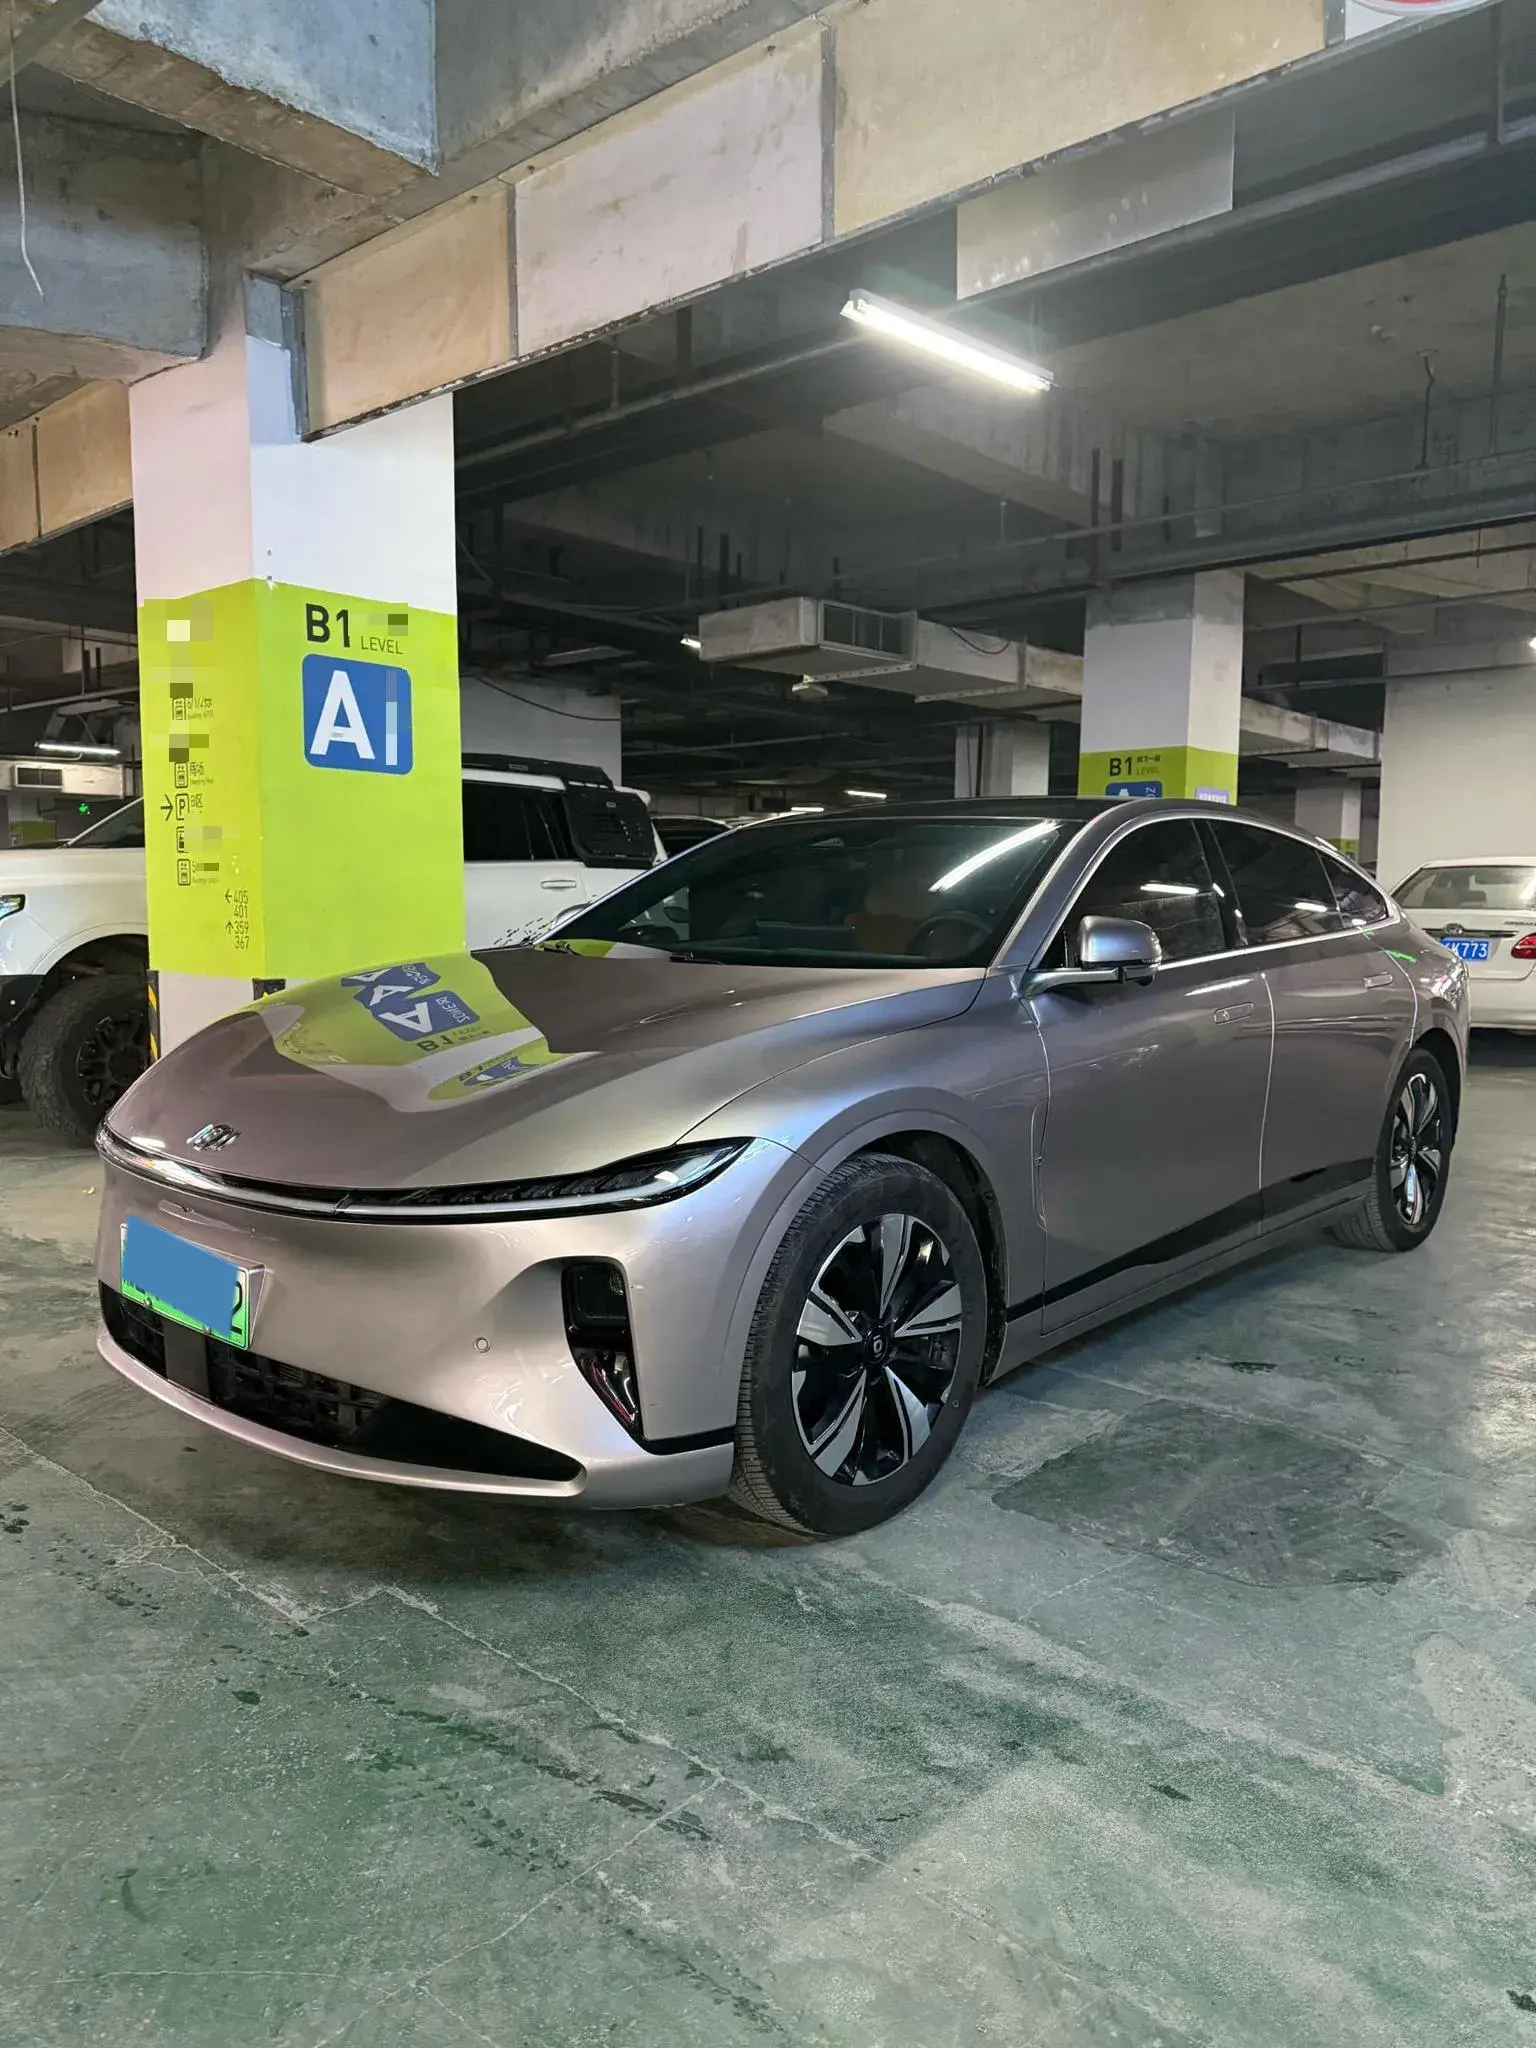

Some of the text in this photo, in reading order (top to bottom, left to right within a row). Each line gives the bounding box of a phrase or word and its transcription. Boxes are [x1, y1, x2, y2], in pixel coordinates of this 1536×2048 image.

[306, 603, 350, 648] B1
[361, 636, 403, 654] LEVEL
[1109, 757, 1132, 776] B1
[233, 890, 249, 905] 405
[233, 905, 249, 918] 401
[234, 921, 249, 935] 359
[235, 936, 250, 950] 367
